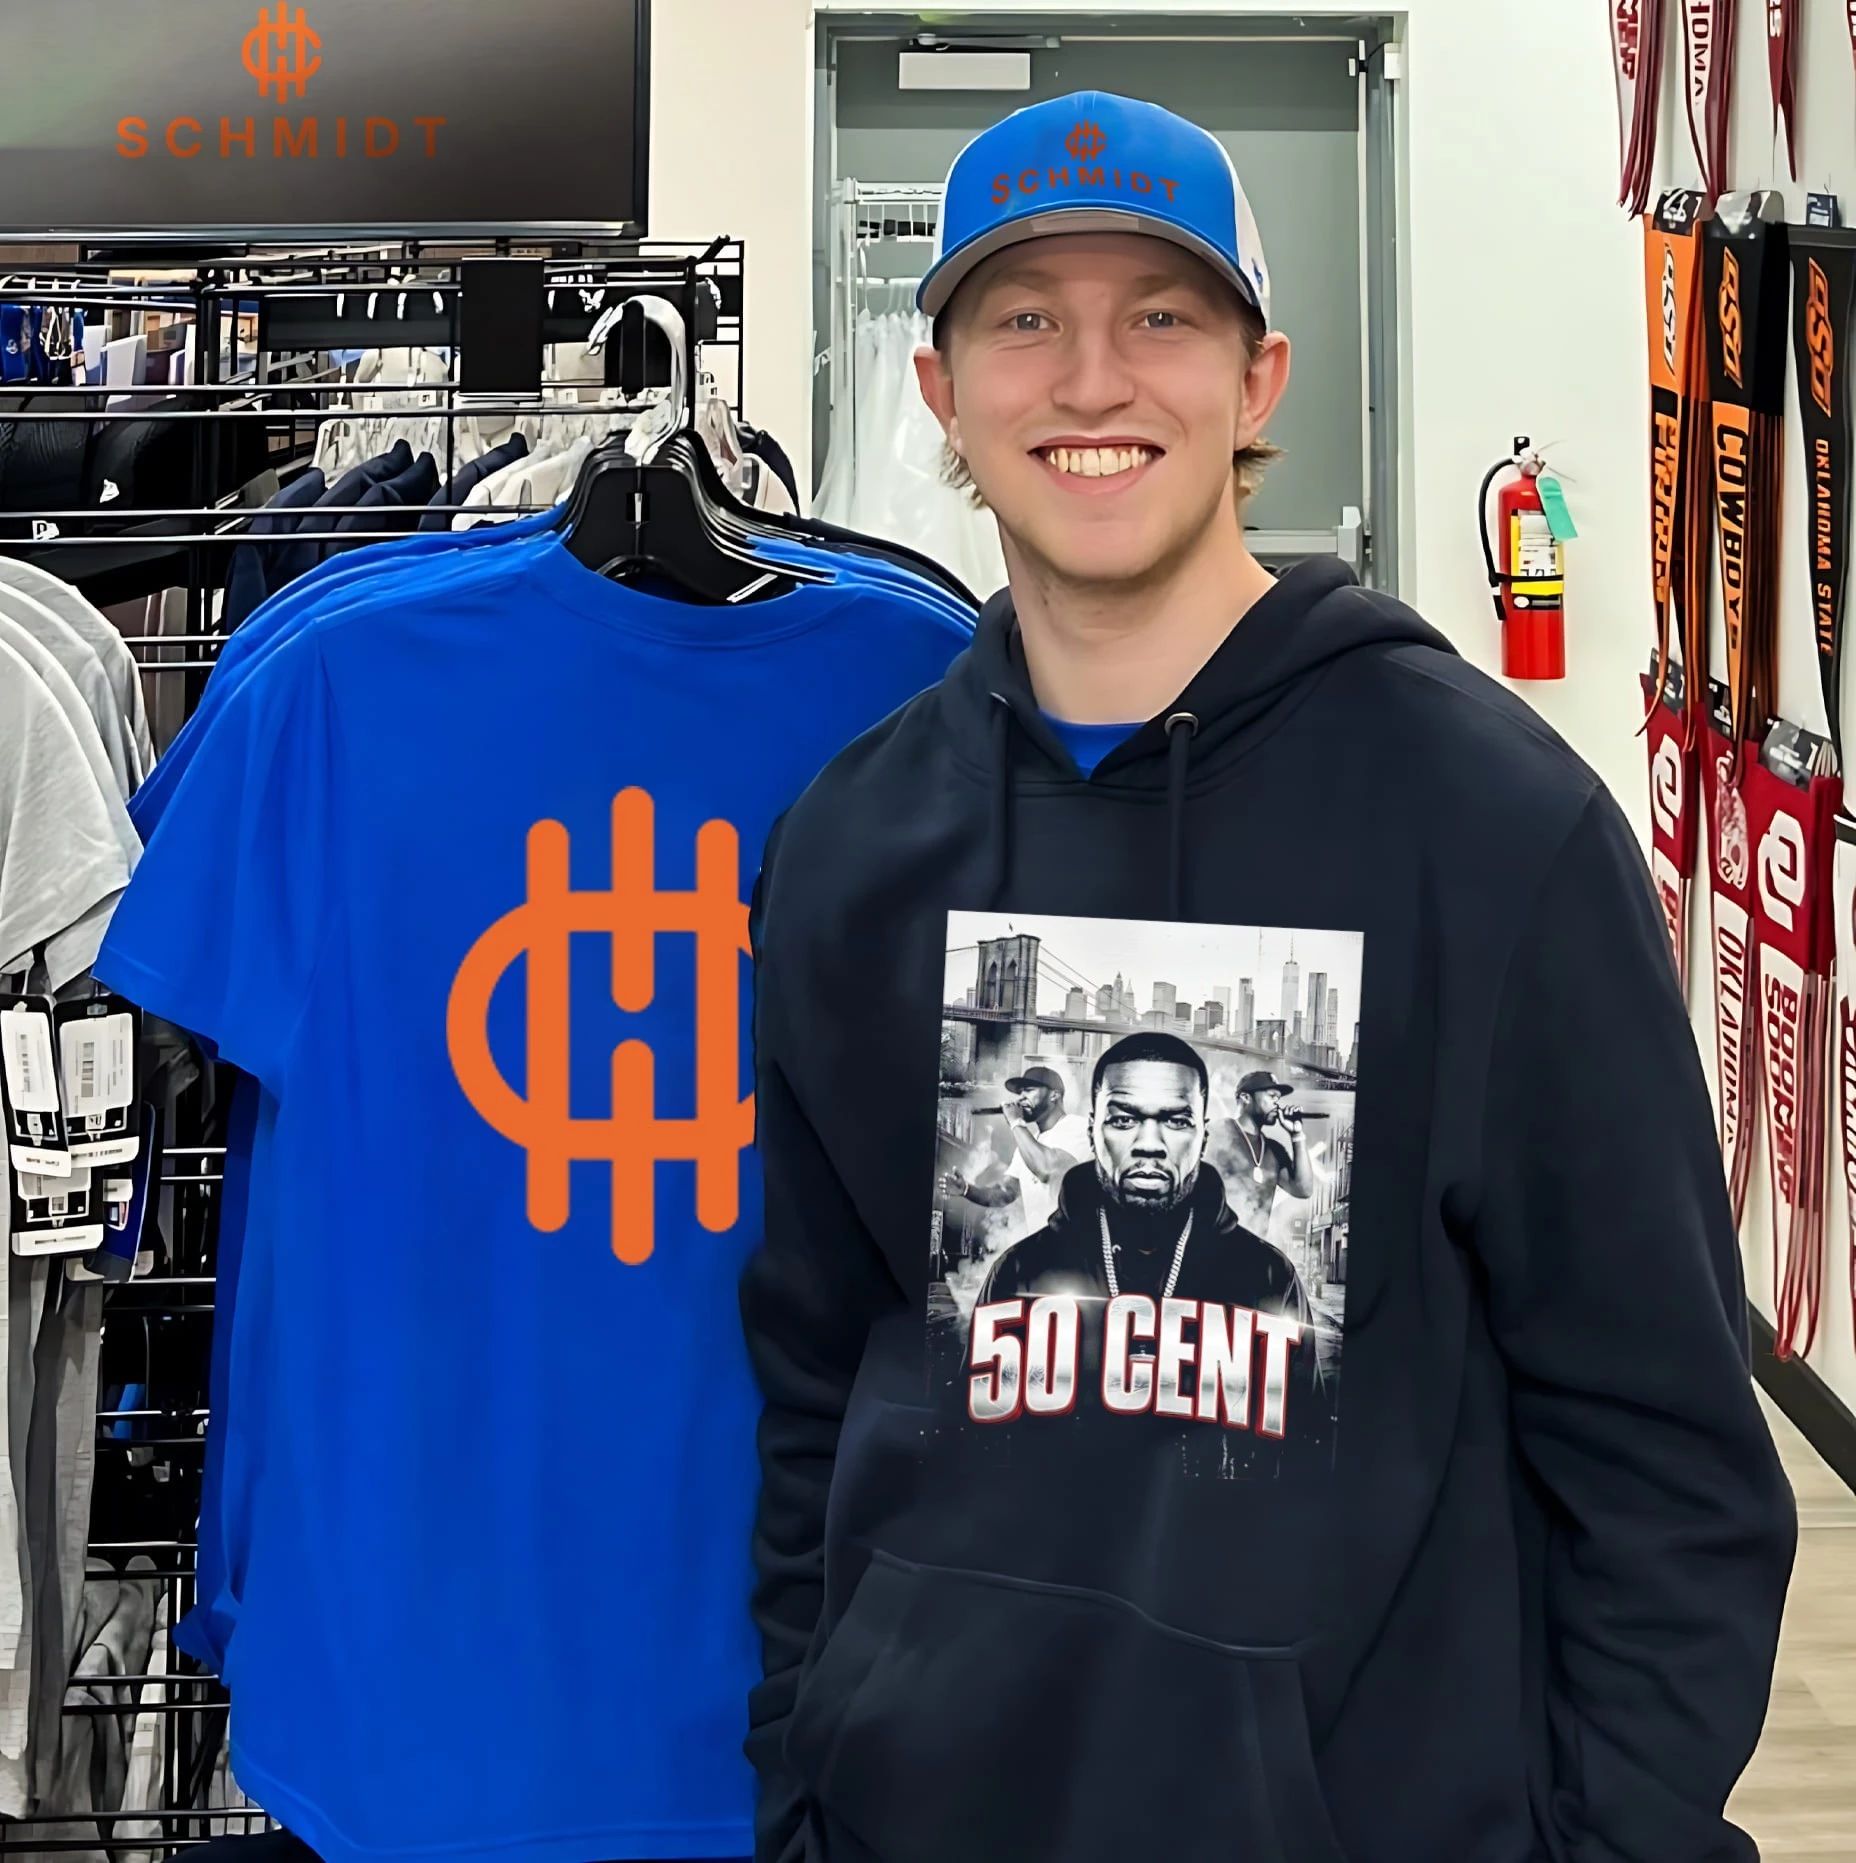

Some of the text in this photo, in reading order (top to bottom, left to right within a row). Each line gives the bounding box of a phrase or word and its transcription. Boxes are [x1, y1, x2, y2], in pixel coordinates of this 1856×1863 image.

[116, 116, 449, 158] SCHMIDT
[990, 166, 1182, 205] SCHMIDT
[1815, 438, 1834, 657] OKLAHOMA STATE
[1718, 926, 1745, 1144] OKLAHOMA
[967, 1293, 1303, 1440] 50 CENT
